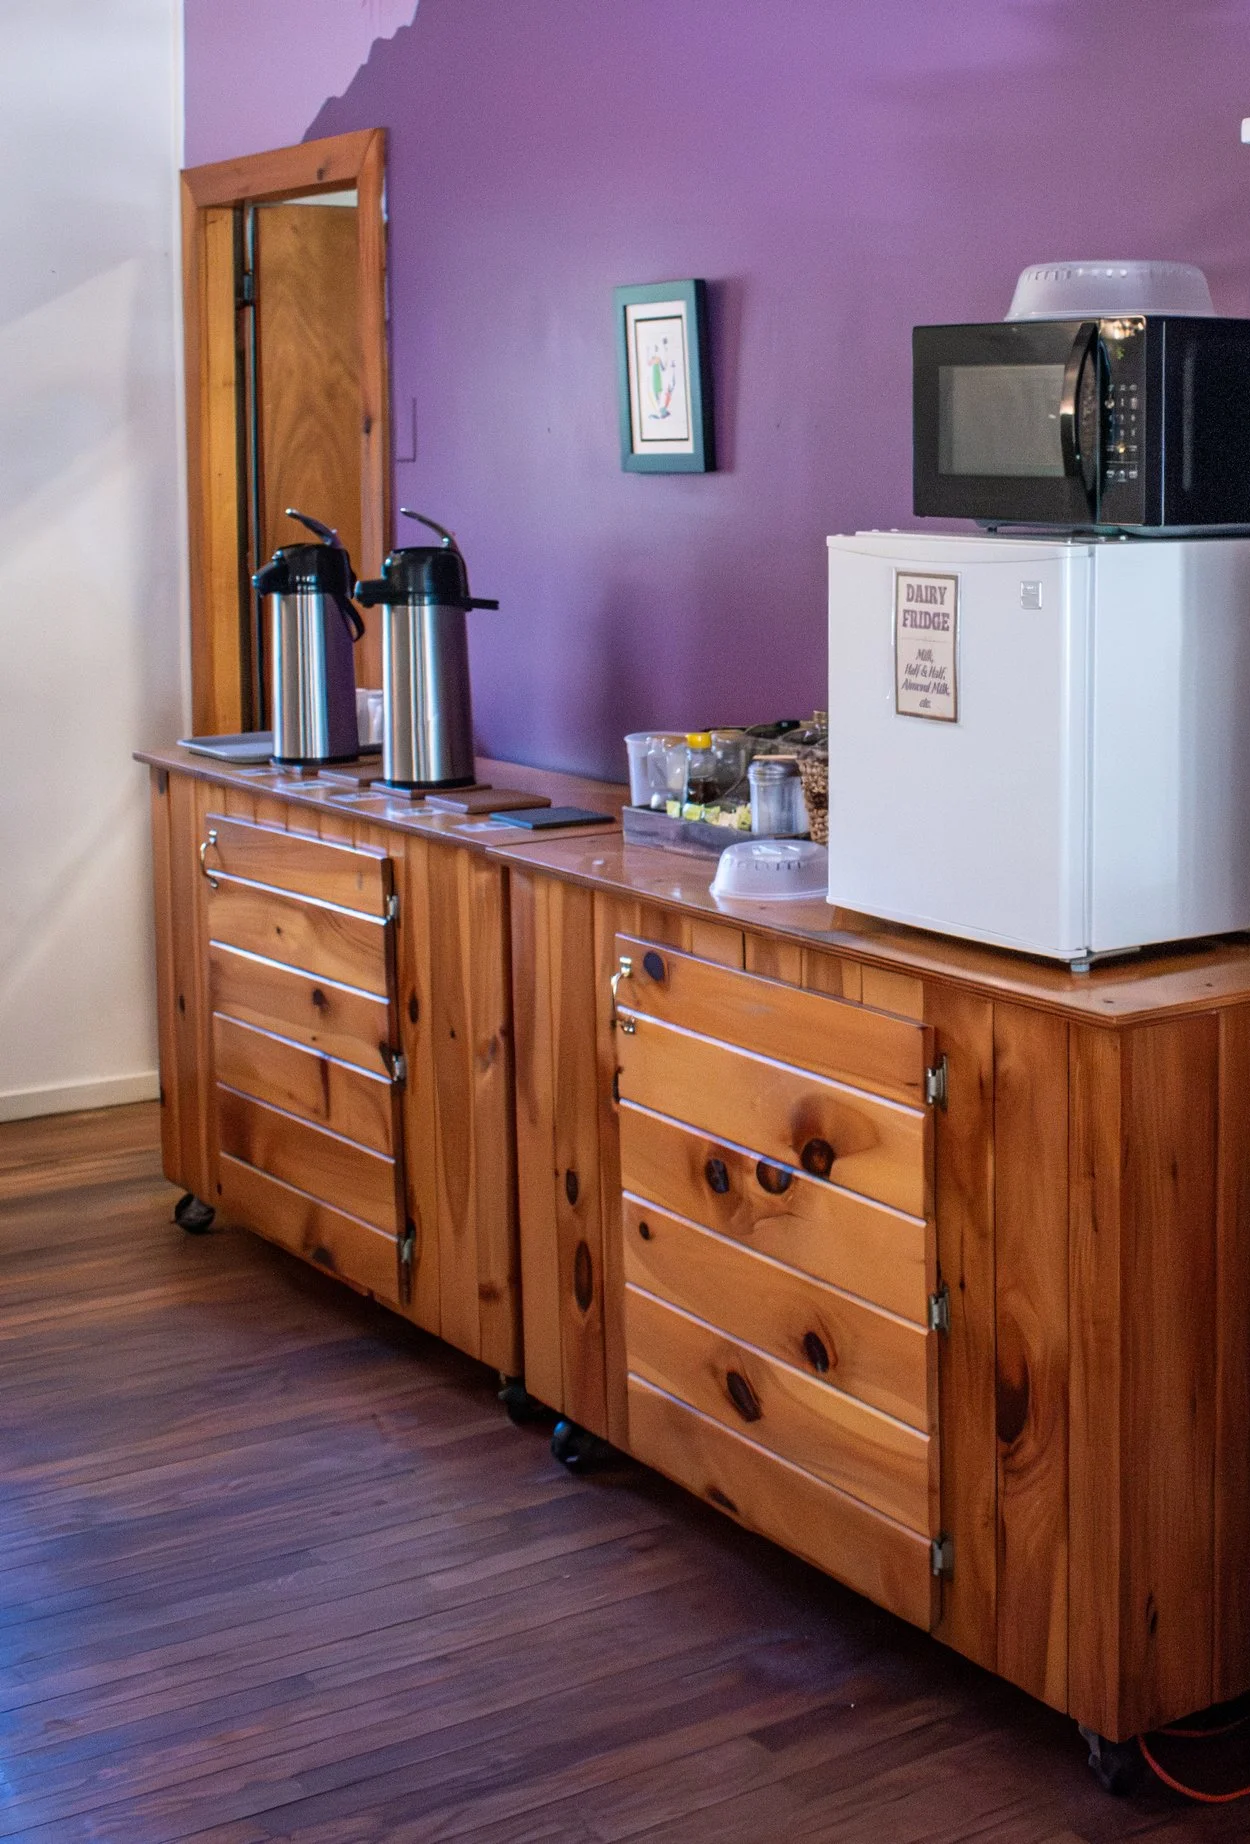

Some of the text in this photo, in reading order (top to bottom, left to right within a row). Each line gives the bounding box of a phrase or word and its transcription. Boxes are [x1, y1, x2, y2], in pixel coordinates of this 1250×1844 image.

[906, 583, 948, 606] DAIRY
[902, 609, 950, 632] FRIDGE
[904, 663, 921, 678] Half
[921, 664, 928, 678] &
